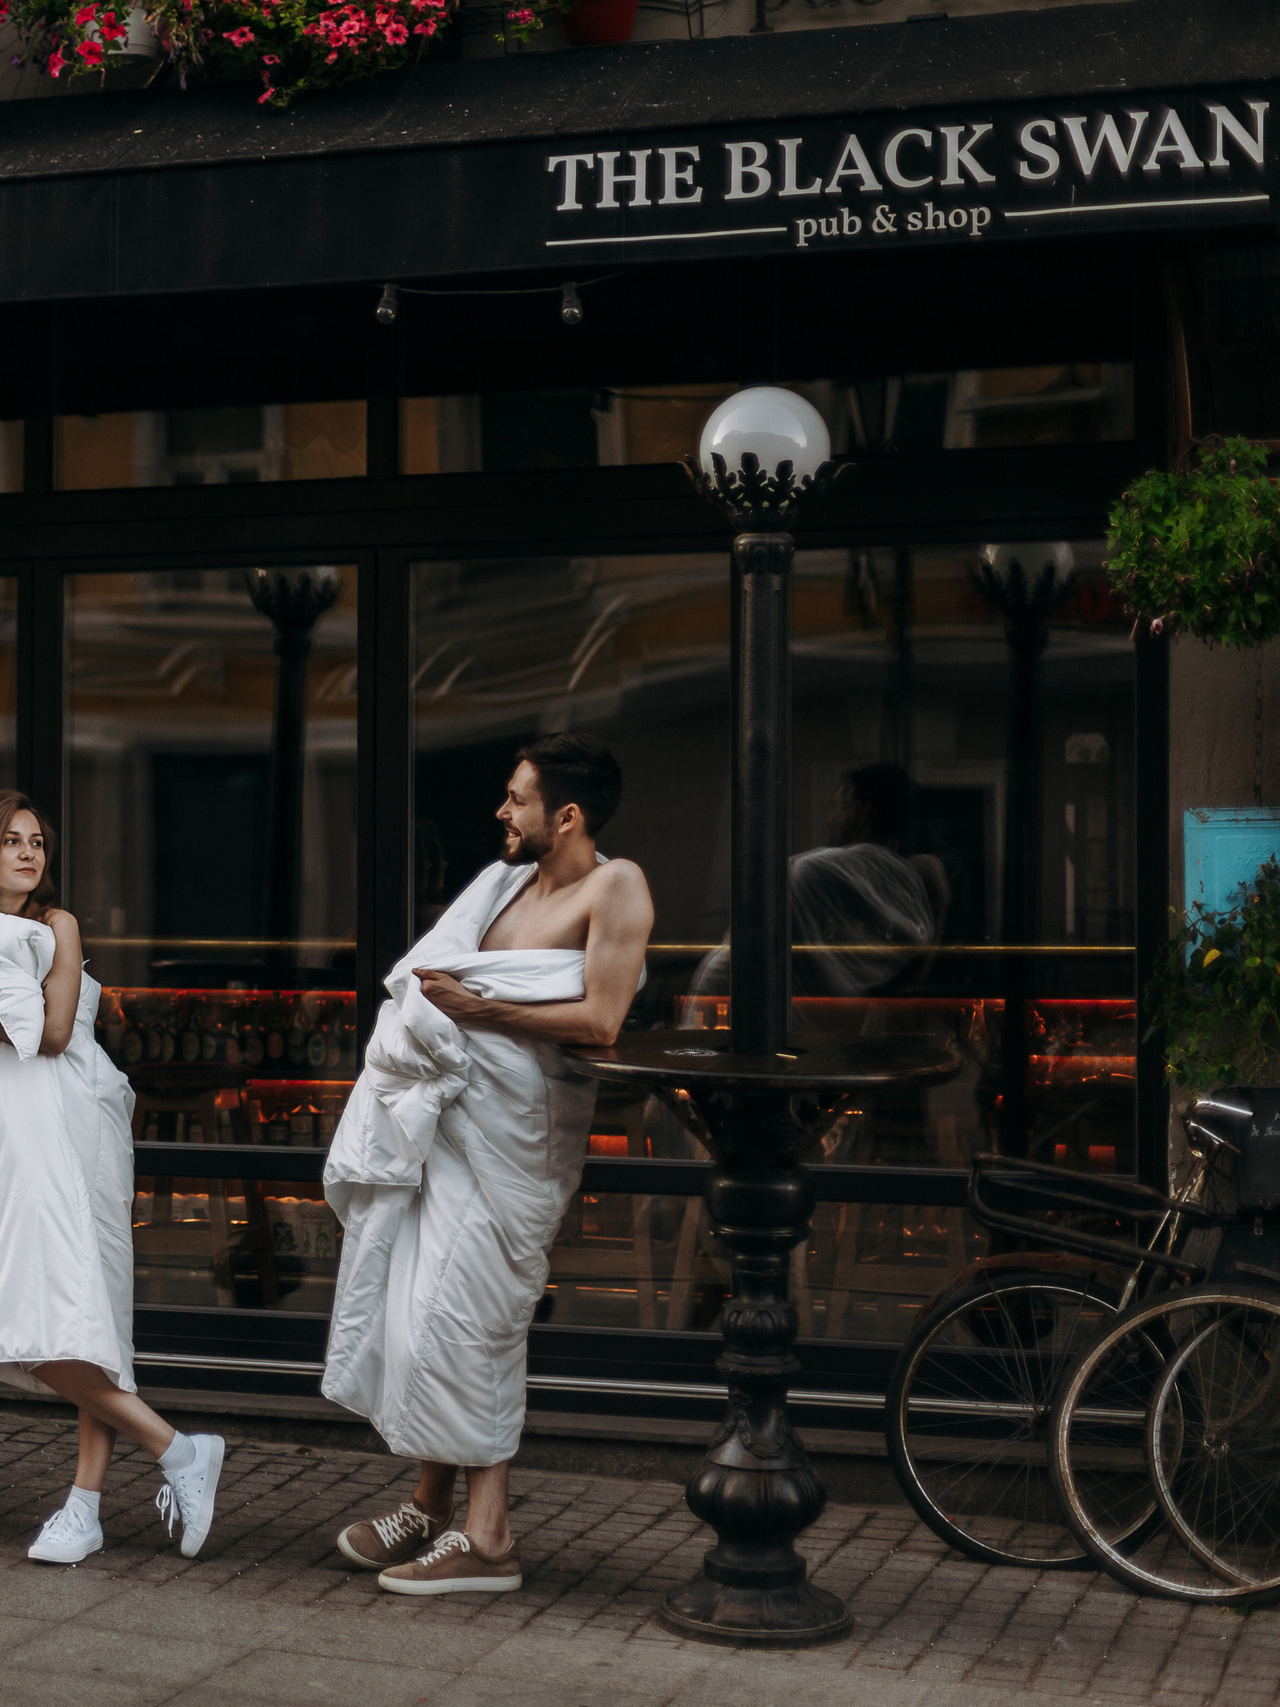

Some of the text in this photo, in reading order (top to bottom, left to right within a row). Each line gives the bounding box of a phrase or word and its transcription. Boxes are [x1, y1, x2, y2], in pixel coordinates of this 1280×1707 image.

[547, 101, 1270, 211] THE BLACK SWAN
[795, 201, 991, 247] pub & shop
